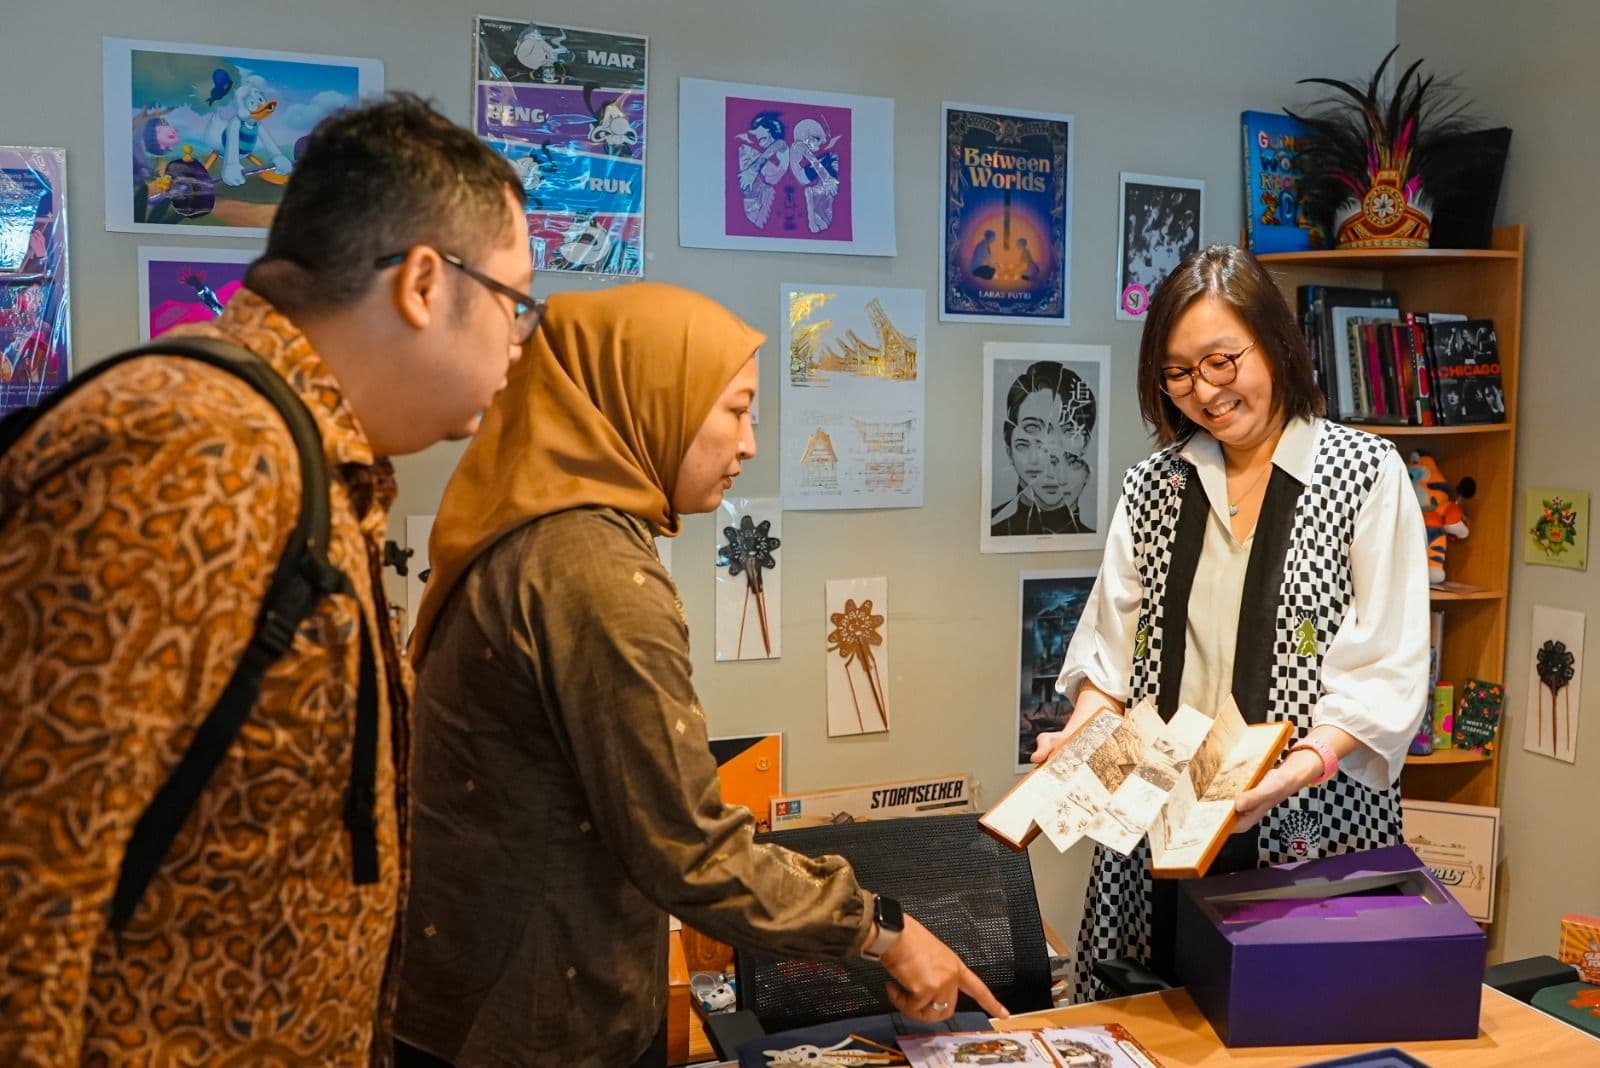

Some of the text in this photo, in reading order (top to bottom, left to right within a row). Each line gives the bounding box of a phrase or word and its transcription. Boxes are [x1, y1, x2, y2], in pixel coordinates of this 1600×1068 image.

[587, 49, 636, 69] MAR
[964, 147, 1051, 174] Between
[968, 166, 1046, 193] Worlds
[1439, 363, 1501, 378] CHICAGO
[870, 780, 963, 809] STORMSEEKER
